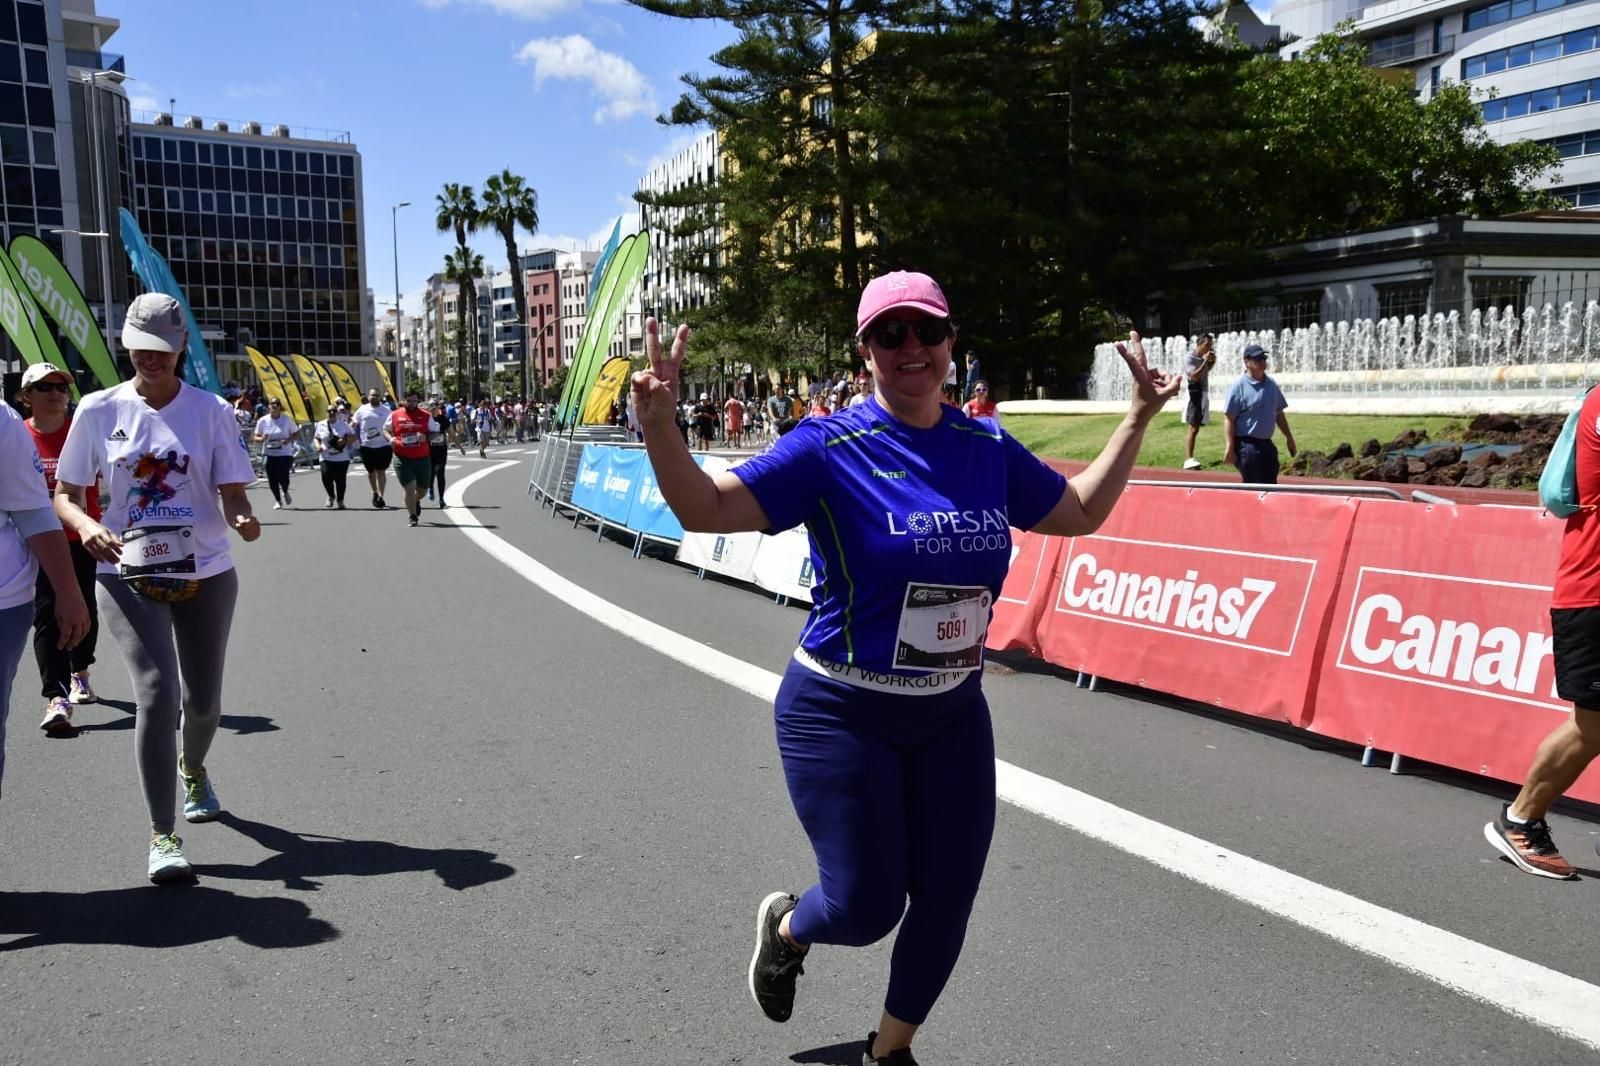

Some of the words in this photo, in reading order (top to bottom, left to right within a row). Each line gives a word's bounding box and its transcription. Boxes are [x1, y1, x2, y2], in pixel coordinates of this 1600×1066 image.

[872, 469, 907, 479] FASTER
[886, 505, 1008, 536] LOPESAN
[142, 542, 171, 558] 3382
[913, 537, 953, 554] FOR
[960, 534, 1007, 552] GOOD
[1064, 553, 1276, 640] Canarias7
[937, 618, 967, 641] 5091
[1349, 594, 1559, 698] Canar
[860, 667, 949, 689] WORKOUT
